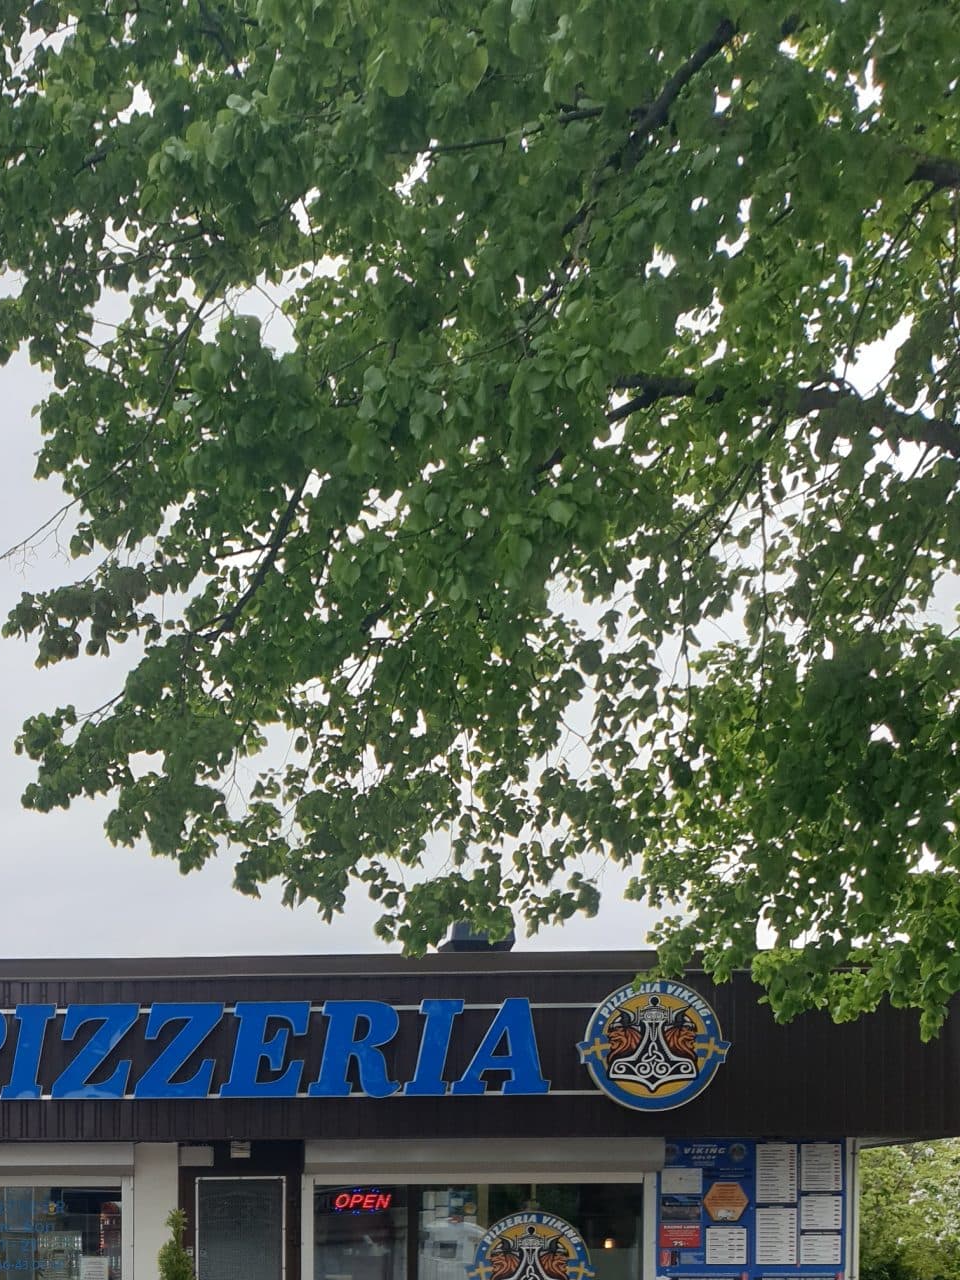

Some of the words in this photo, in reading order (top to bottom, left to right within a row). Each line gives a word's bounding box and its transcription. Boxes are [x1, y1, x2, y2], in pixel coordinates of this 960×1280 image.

[666, 984, 712, 1017] VIKING
[335, 1193, 392, 1209] OPEN
[484, 1214, 538, 1245] PIZZERIA
[541, 1215, 581, 1244] VIKING
